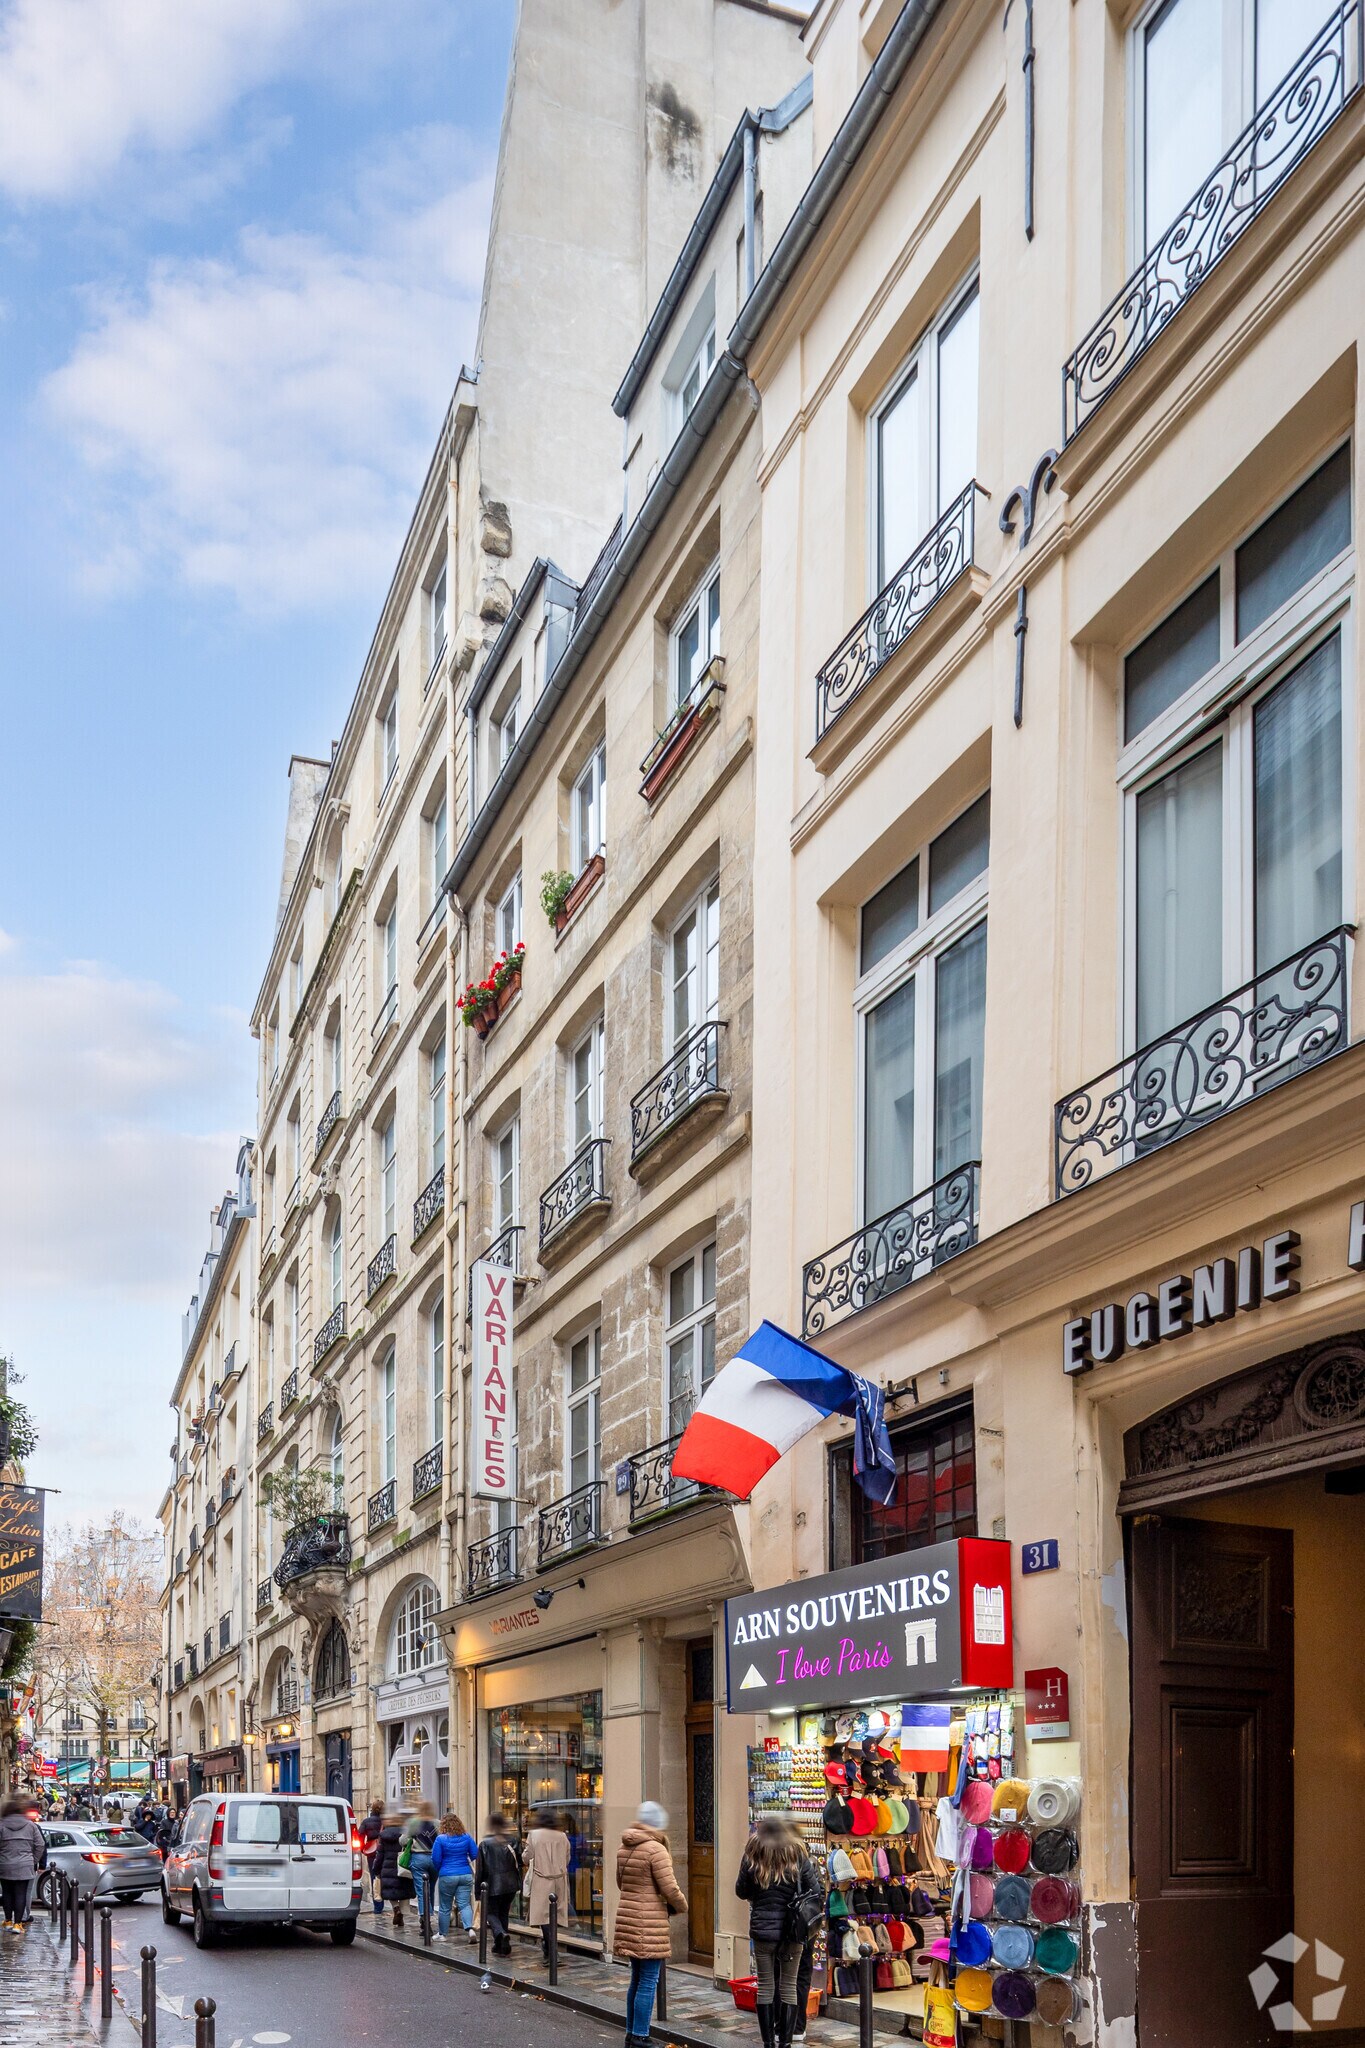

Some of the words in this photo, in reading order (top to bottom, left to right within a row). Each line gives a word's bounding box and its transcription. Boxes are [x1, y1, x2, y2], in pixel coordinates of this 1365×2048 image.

[1063, 1230, 1300, 1376] EUGENIE
[483, 1272, 507, 1488] VARIANTES
[0, 1493, 40, 1517] Café
[0, 1518, 41, 1538] Latin
[1029, 1543, 1050, 1569] 31
[0, 1569, 40, 1595] ESTAURANT
[733, 1608, 781, 1645] ARN
[786, 1569, 951, 1634] SOUVENIRS
[489, 1608, 540, 1635] VARIANTES
[776, 1649, 790, 1684] I
[794, 1647, 832, 1679] love
[837, 1637, 894, 1676] Paris
[1045, 1677, 1063, 1698] H
[311, 1833, 337, 1842] PRESSE
